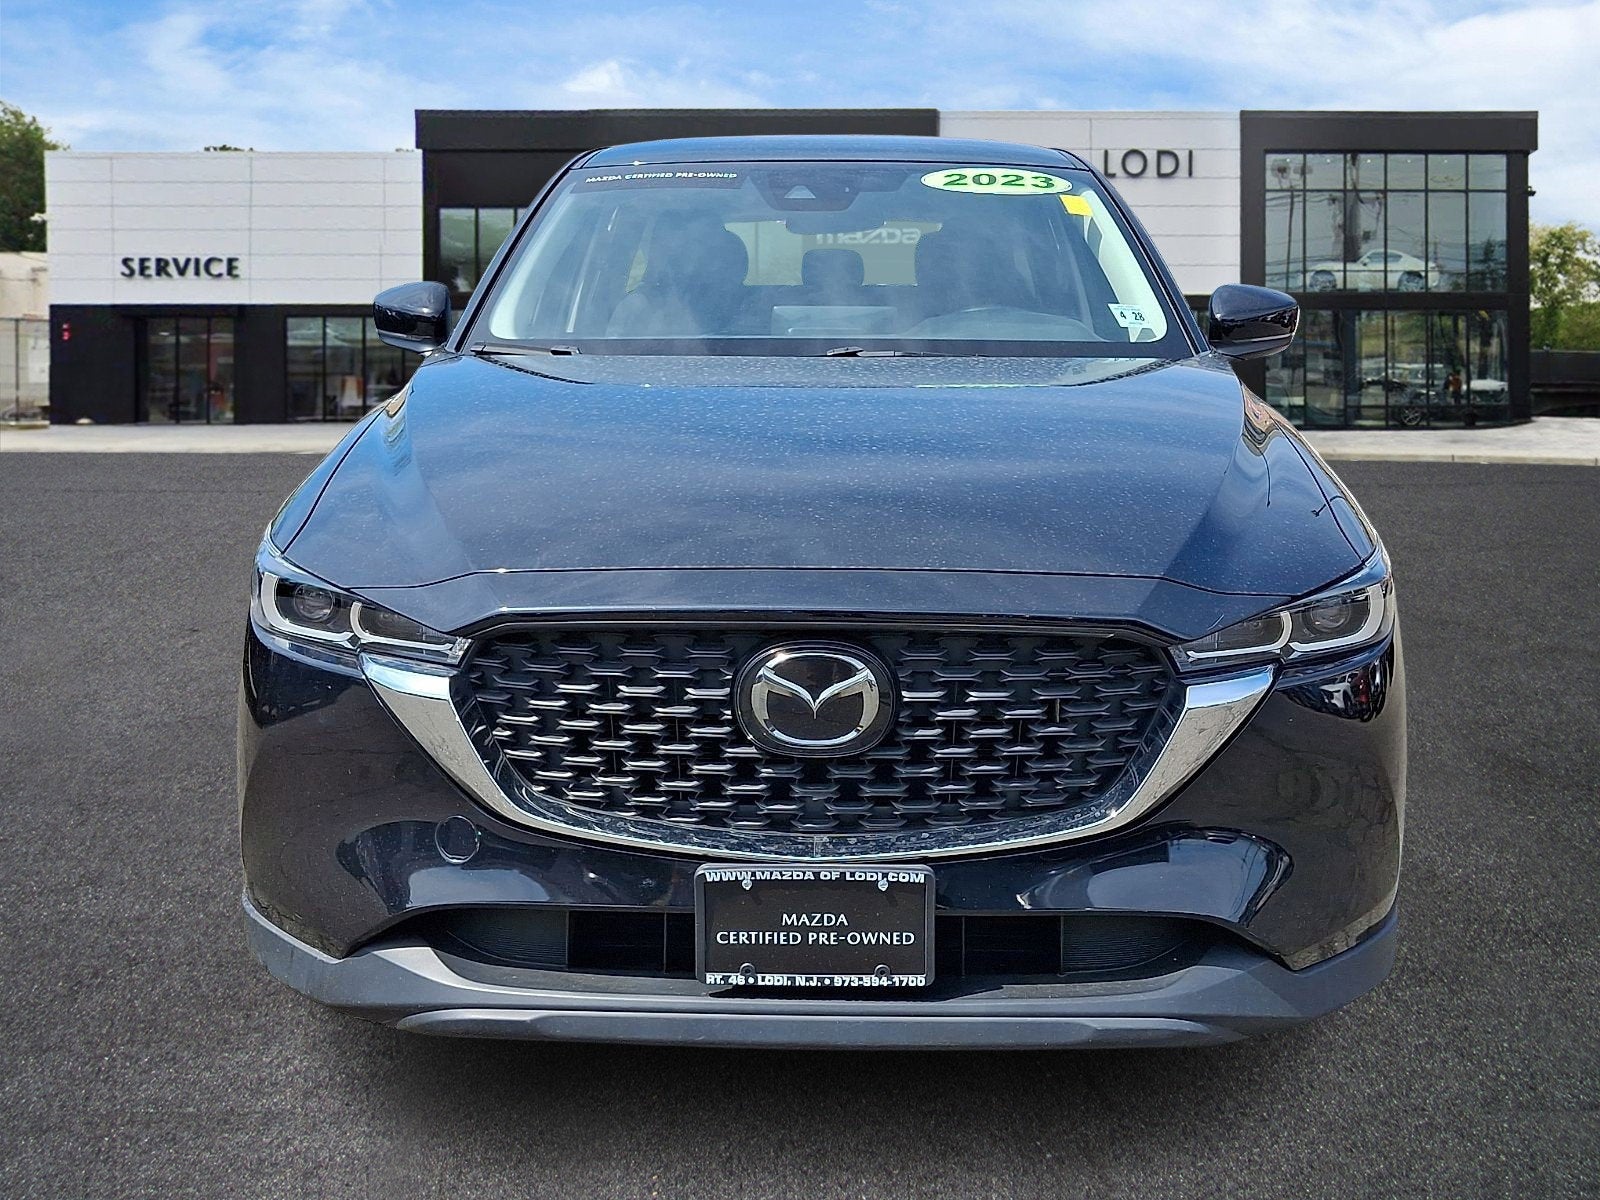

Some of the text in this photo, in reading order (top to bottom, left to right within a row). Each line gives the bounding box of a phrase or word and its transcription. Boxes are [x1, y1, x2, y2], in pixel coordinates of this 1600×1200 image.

[1103, 149, 1193, 178] LODI
[586, 171, 738, 183] MAZDA CERTIFIED PRE-OWNED
[943, 173, 1055, 189] 2023
[120, 257, 240, 279] SERVICE
[705, 870, 815, 882] WWW.MAZDA
[819, 871, 841, 881] OF
[781, 913, 849, 926] MAZDA
[716, 931, 915, 945] CERTIFIED PRE-OWNED
[706, 974, 725, 985] RT.
[833, 976, 926, 987] 973-594-1700
